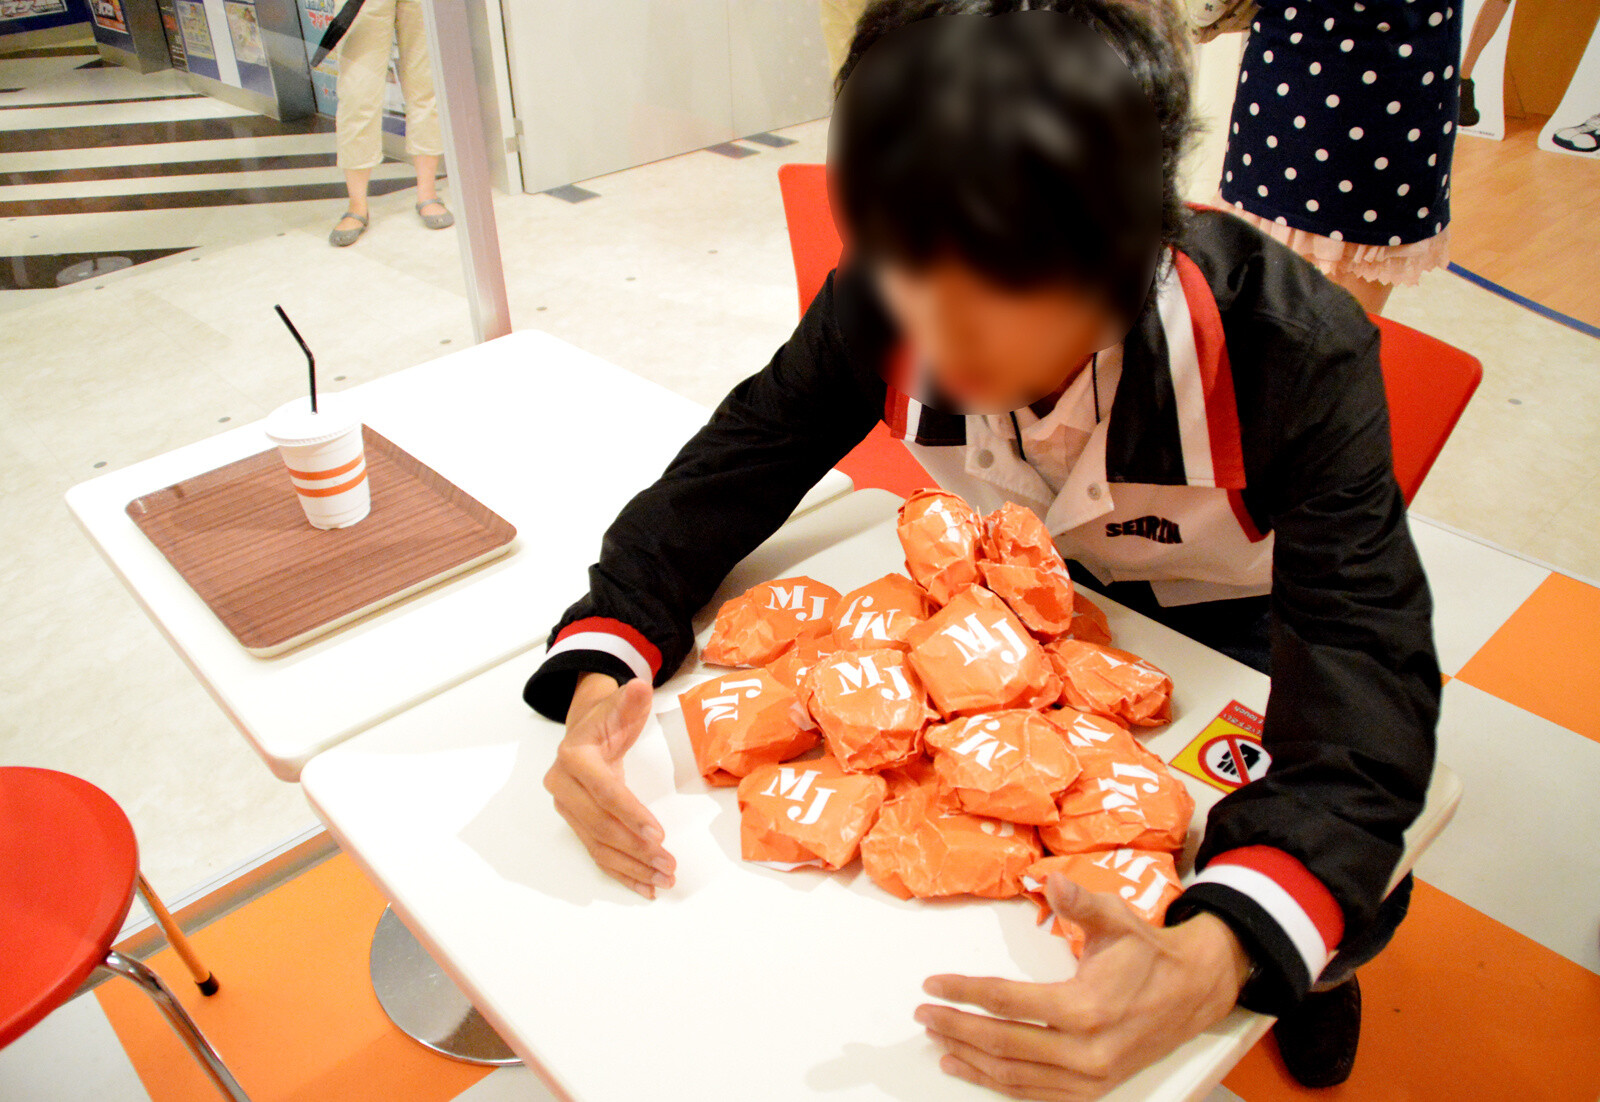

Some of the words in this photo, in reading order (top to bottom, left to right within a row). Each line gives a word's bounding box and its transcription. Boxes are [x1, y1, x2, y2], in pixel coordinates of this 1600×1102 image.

[1105, 514, 1183, 545] SEIRIN
[767, 584, 829, 622] MJ
[837, 594, 900, 640] MJ
[941, 612, 1029, 666] MJ
[701, 677, 763, 733] MJ
[837, 655, 912, 701] MJ
[1234, 705, 1258, 721] touch
[951, 714, 1019, 771] MJ
[761, 767, 837, 826] MJ
[1098, 762, 1160, 820] MJ
[1092, 848, 1169, 910] MJ
